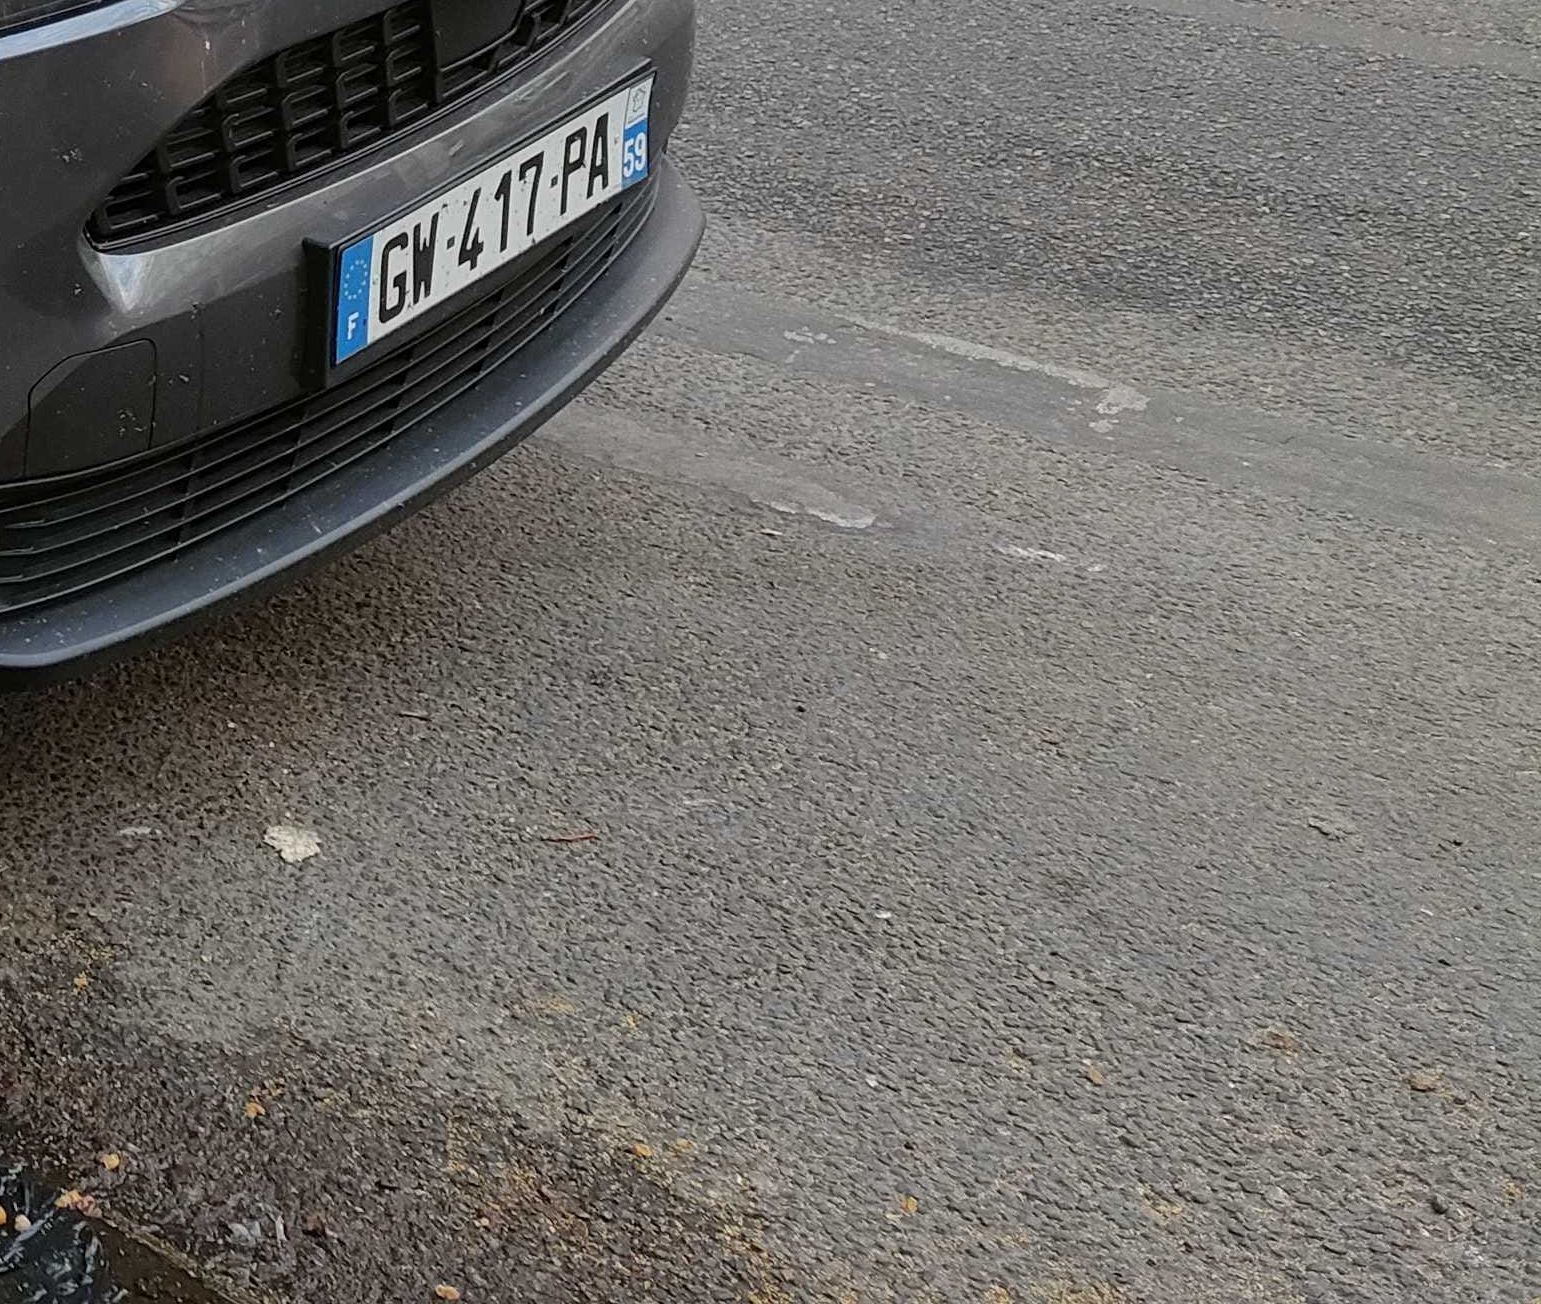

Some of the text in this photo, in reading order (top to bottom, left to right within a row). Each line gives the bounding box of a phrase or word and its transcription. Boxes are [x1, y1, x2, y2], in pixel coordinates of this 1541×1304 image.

[346, 112, 647, 341] F GW-417-PA 59
